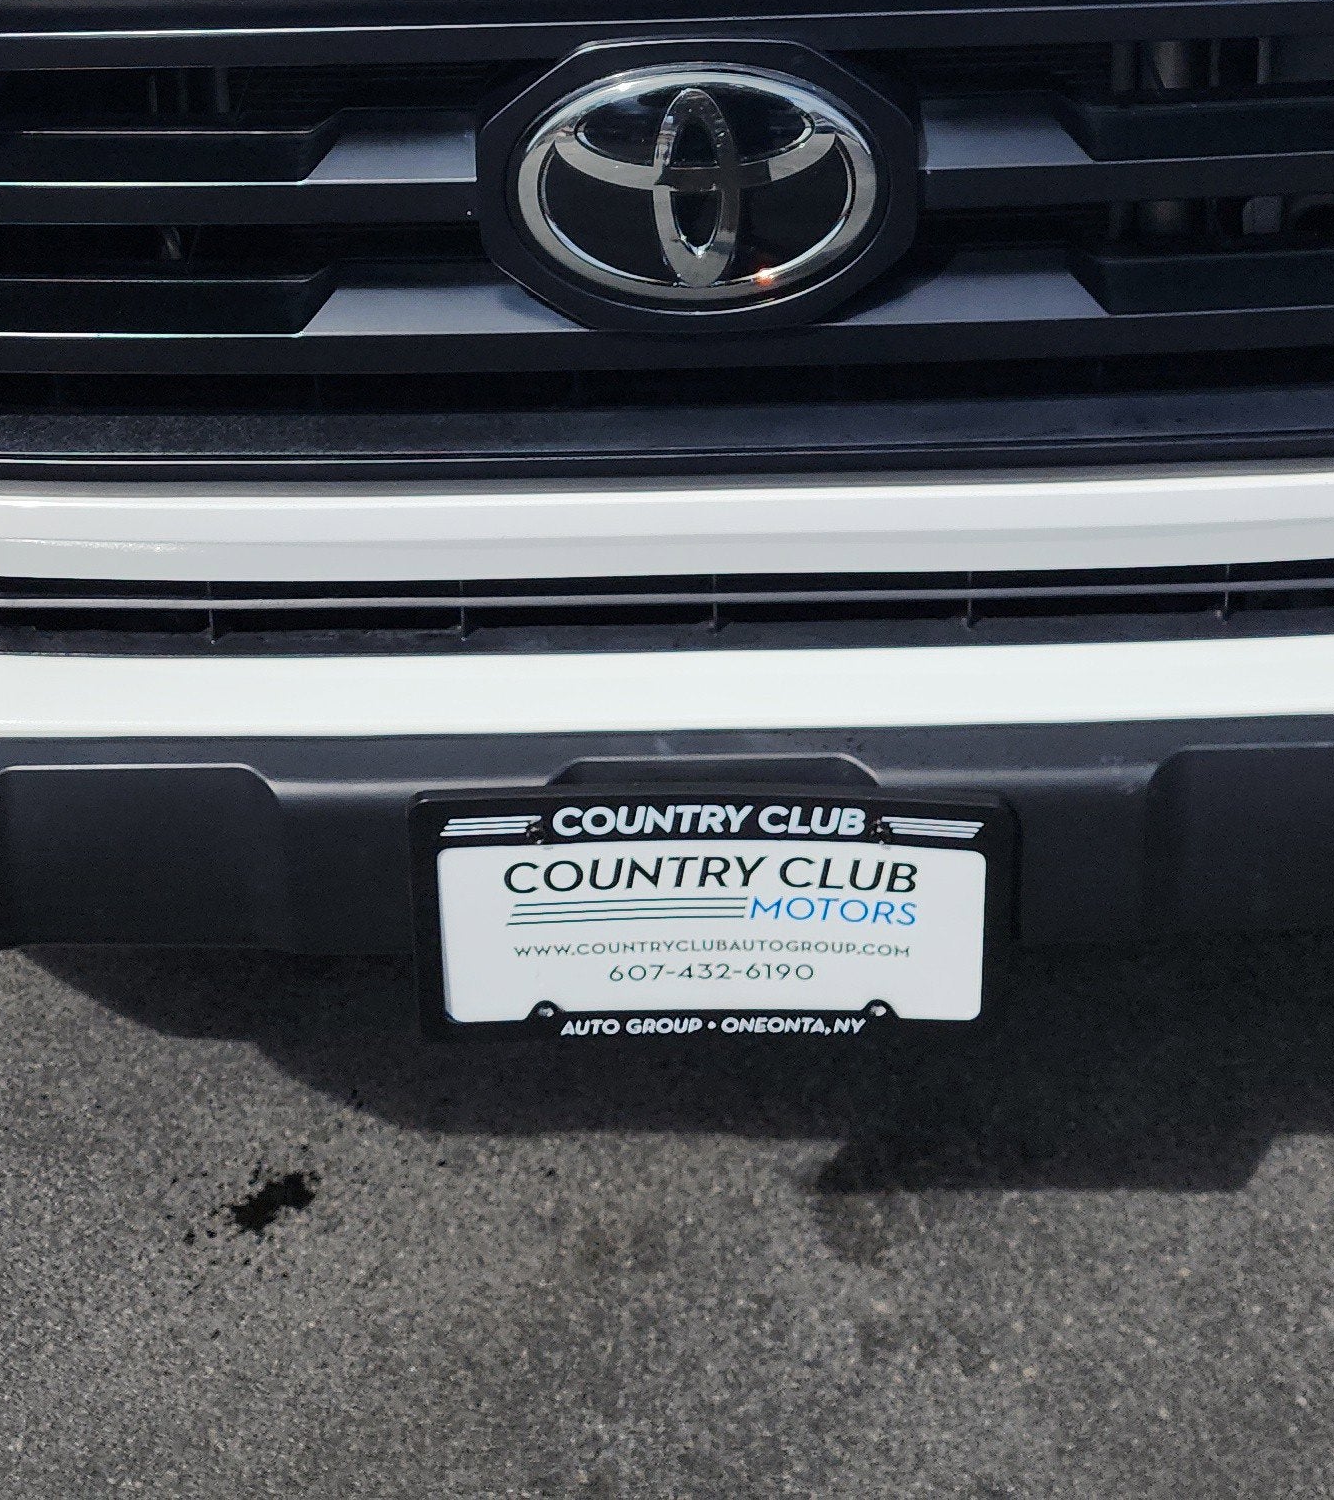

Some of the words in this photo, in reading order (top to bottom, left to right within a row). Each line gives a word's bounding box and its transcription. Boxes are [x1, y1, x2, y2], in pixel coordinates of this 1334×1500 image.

[552, 803, 755, 837] COUNTRY
[757, 804, 867, 837] CLUB
[503, 854, 768, 894] COUNTRY
[779, 855, 918, 894] CLUB
[749, 895, 918, 926] MOTORS
[513, 938, 911, 958] WWW.COUNTRYCLUBAUTOGROUP.COM
[608, 962, 815, 982] 607-432-6190
[559, 1017, 621, 1037] AUTO
[624, 1017, 704, 1035] GROUP
